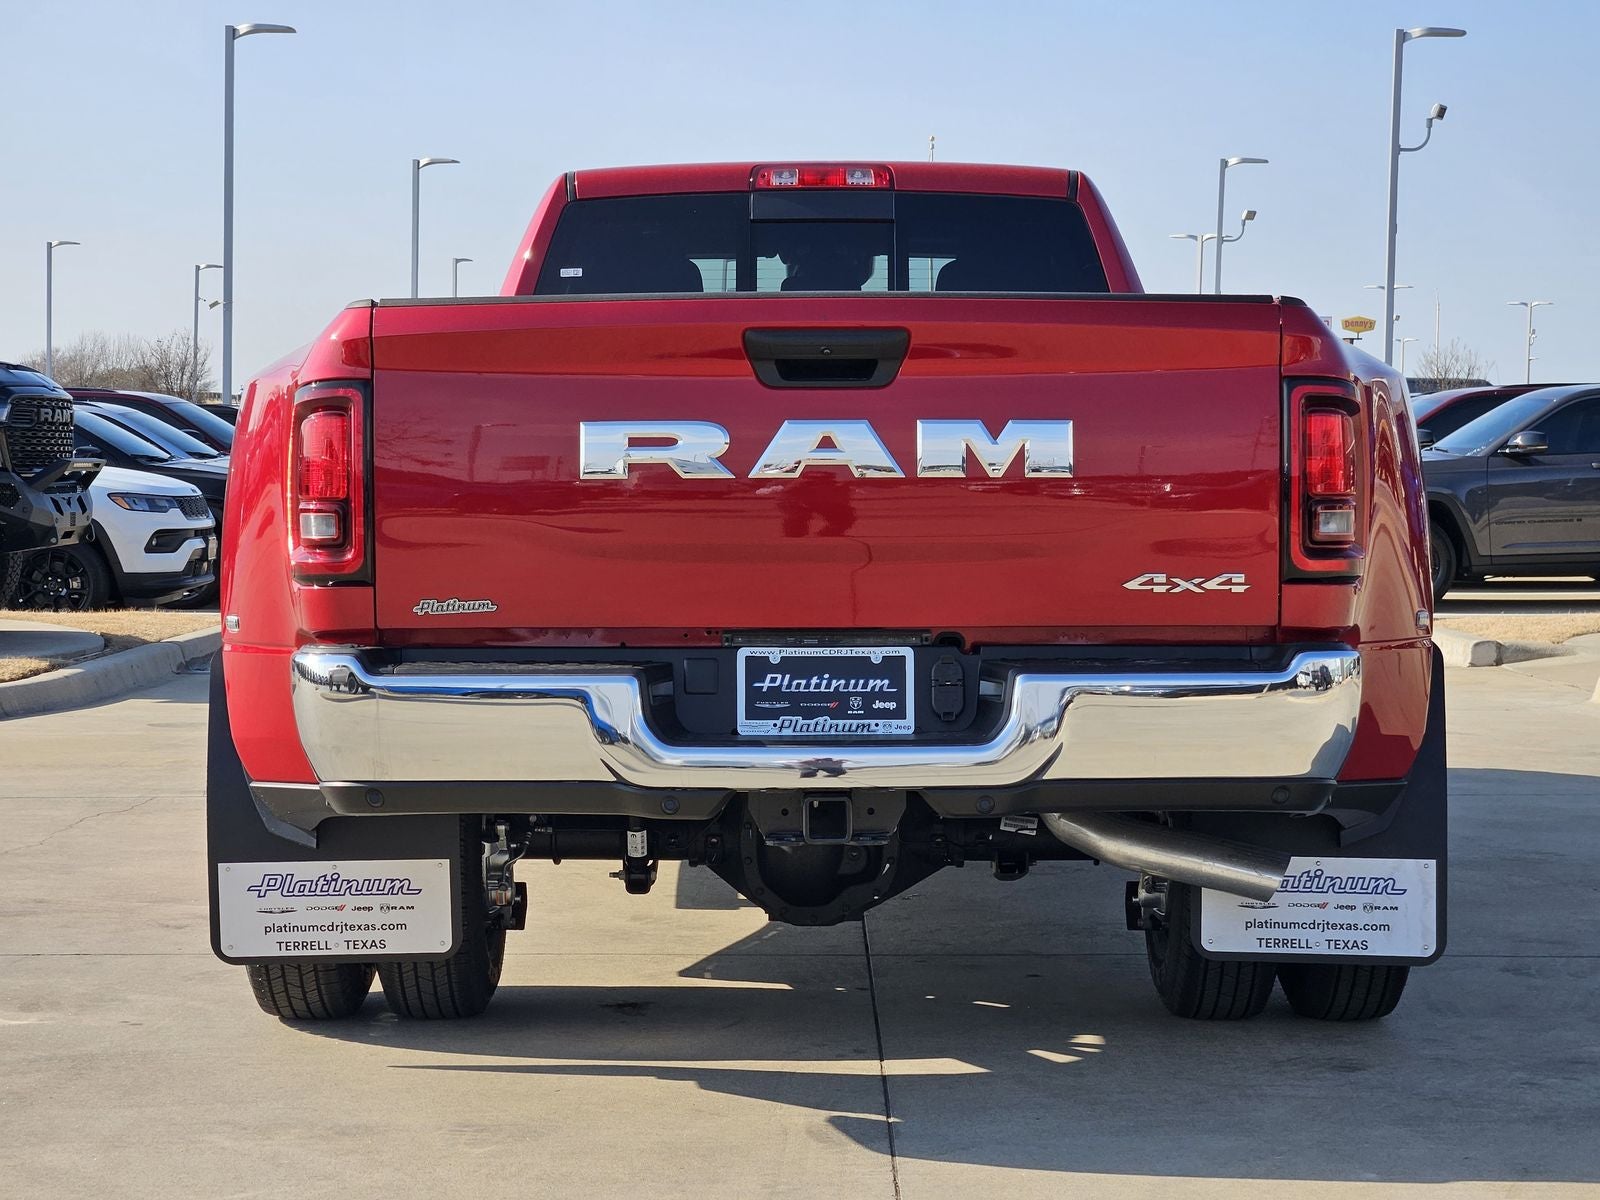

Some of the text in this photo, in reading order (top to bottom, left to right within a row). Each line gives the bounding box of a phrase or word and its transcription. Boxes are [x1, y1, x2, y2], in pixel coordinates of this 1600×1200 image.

[1344, 320, 1374, 328] Denny's
[579, 419, 1074, 479] RAM
[1122, 573, 1250, 593] 4x4
[413, 599, 497, 615] Platinum
[752, 673, 898, 692] Platinum
[872, 700, 897, 710] Jeep
[777, 718, 881, 734] Platinum
[247, 872, 423, 898] Platinum
[1275, 868, 1408, 895] atinum
[351, 905, 374, 913] Jeep
[1333, 903, 1357, 911] Jeep
[264, 921, 407, 935] platinumcdrjtexas.com
[1245, 918, 1391, 932] platinumcdrjtexas.com
[276, 939, 387, 951] TERRELL TEXAS
[1256, 937, 1369, 950] TERRELL TEXAS
